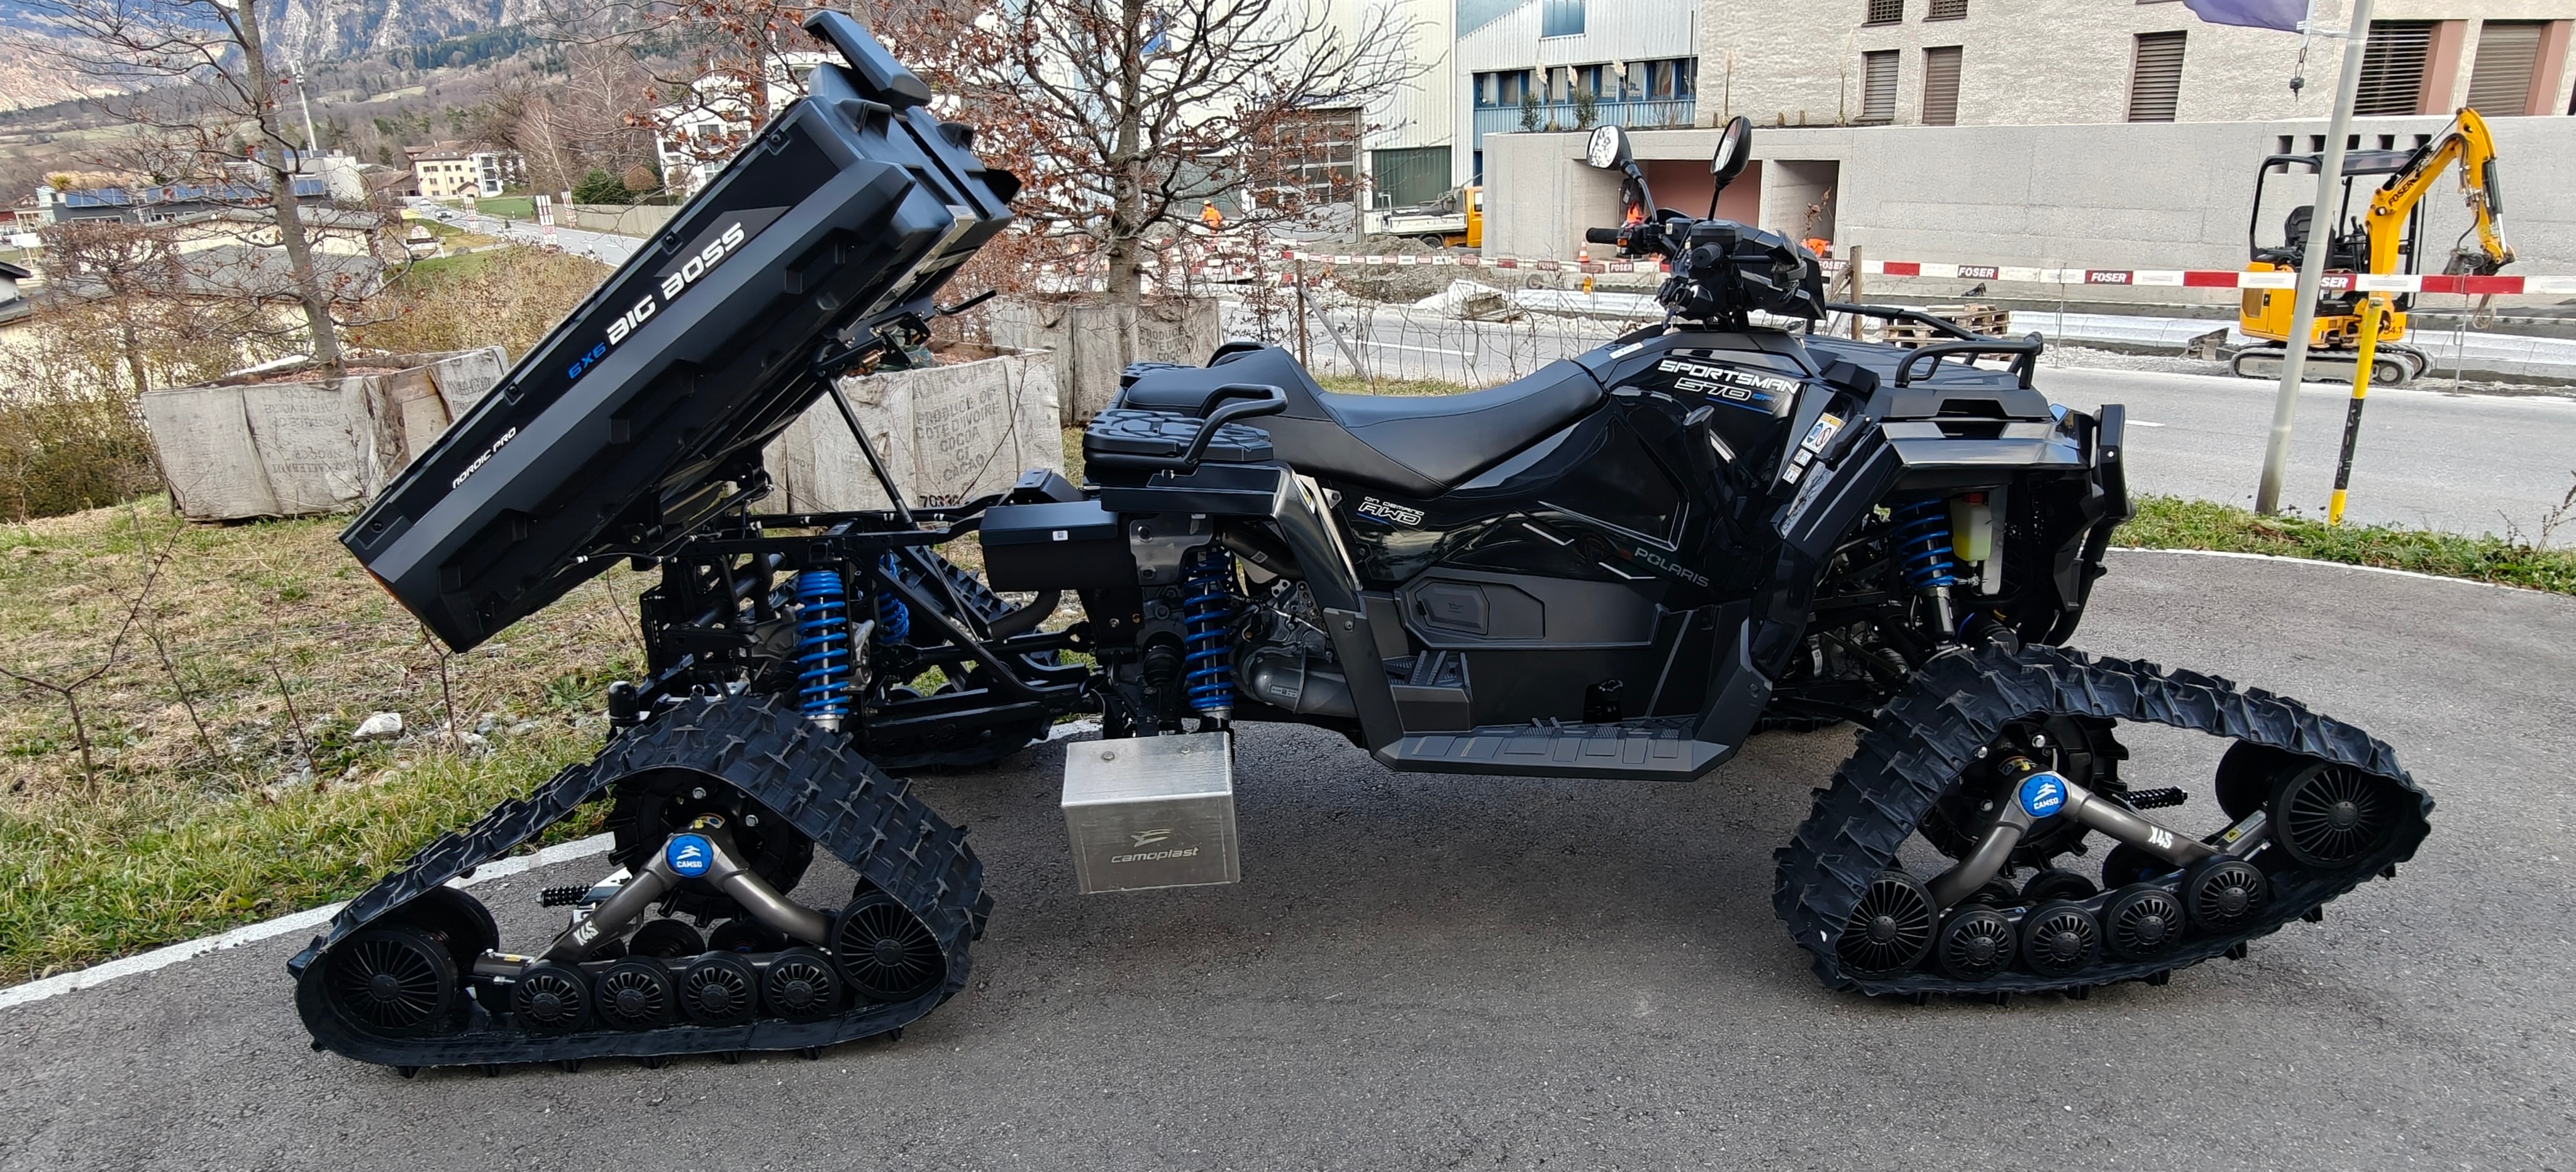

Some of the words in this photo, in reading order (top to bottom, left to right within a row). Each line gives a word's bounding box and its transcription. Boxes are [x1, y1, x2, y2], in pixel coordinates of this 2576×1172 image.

[2388, 180, 2414, 206] FOSER
[1611, 263, 1633, 272] FOSER
[1958, 267, 1995, 278] FOSER
[2090, 272, 2127, 283] FOSER
[2320, 277, 2348, 288] SER
[568, 341, 606, 379] 6X6
[606, 294, 656, 345] BIG
[662, 221, 745, 301] BOSS
[1658, 360, 1801, 394] SPORTSMAN
[1674, 377, 1752, 401] 570
[916, 423, 950, 439] COTE
[940, 426, 981, 452] COCOA
[453, 449, 491, 489] NORDIC
[493, 427, 516, 452] PRO
[943, 453, 985, 482] CACAO
[1358, 502, 1421, 526] AWD
[1382, 501, 1425, 516] DEMAND
[1634, 547, 1709, 587] POLARIS
[2033, 797, 2059, 810] CAMSO
[2148, 826, 2174, 849] X4S
[1111, 847, 1199, 863] camoplast
